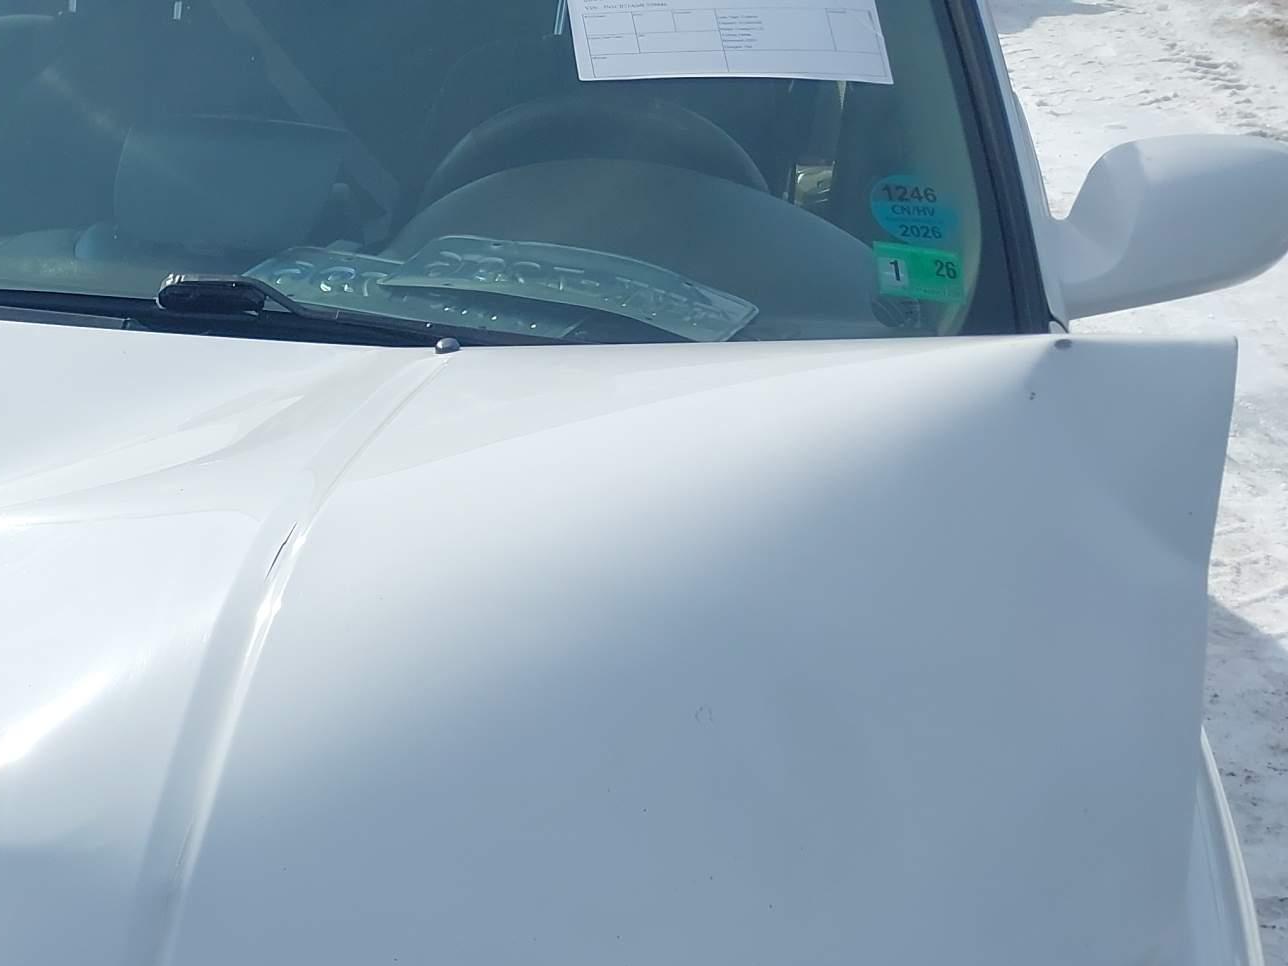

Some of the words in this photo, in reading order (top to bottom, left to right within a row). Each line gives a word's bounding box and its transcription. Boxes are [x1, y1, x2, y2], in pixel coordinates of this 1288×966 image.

[882, 185, 937, 203] 1246
[891, 204, 935, 216] CN/HV
[899, 224, 942, 239] 2026
[889, 260, 901, 281] 1
[934, 259, 957, 280] 26
